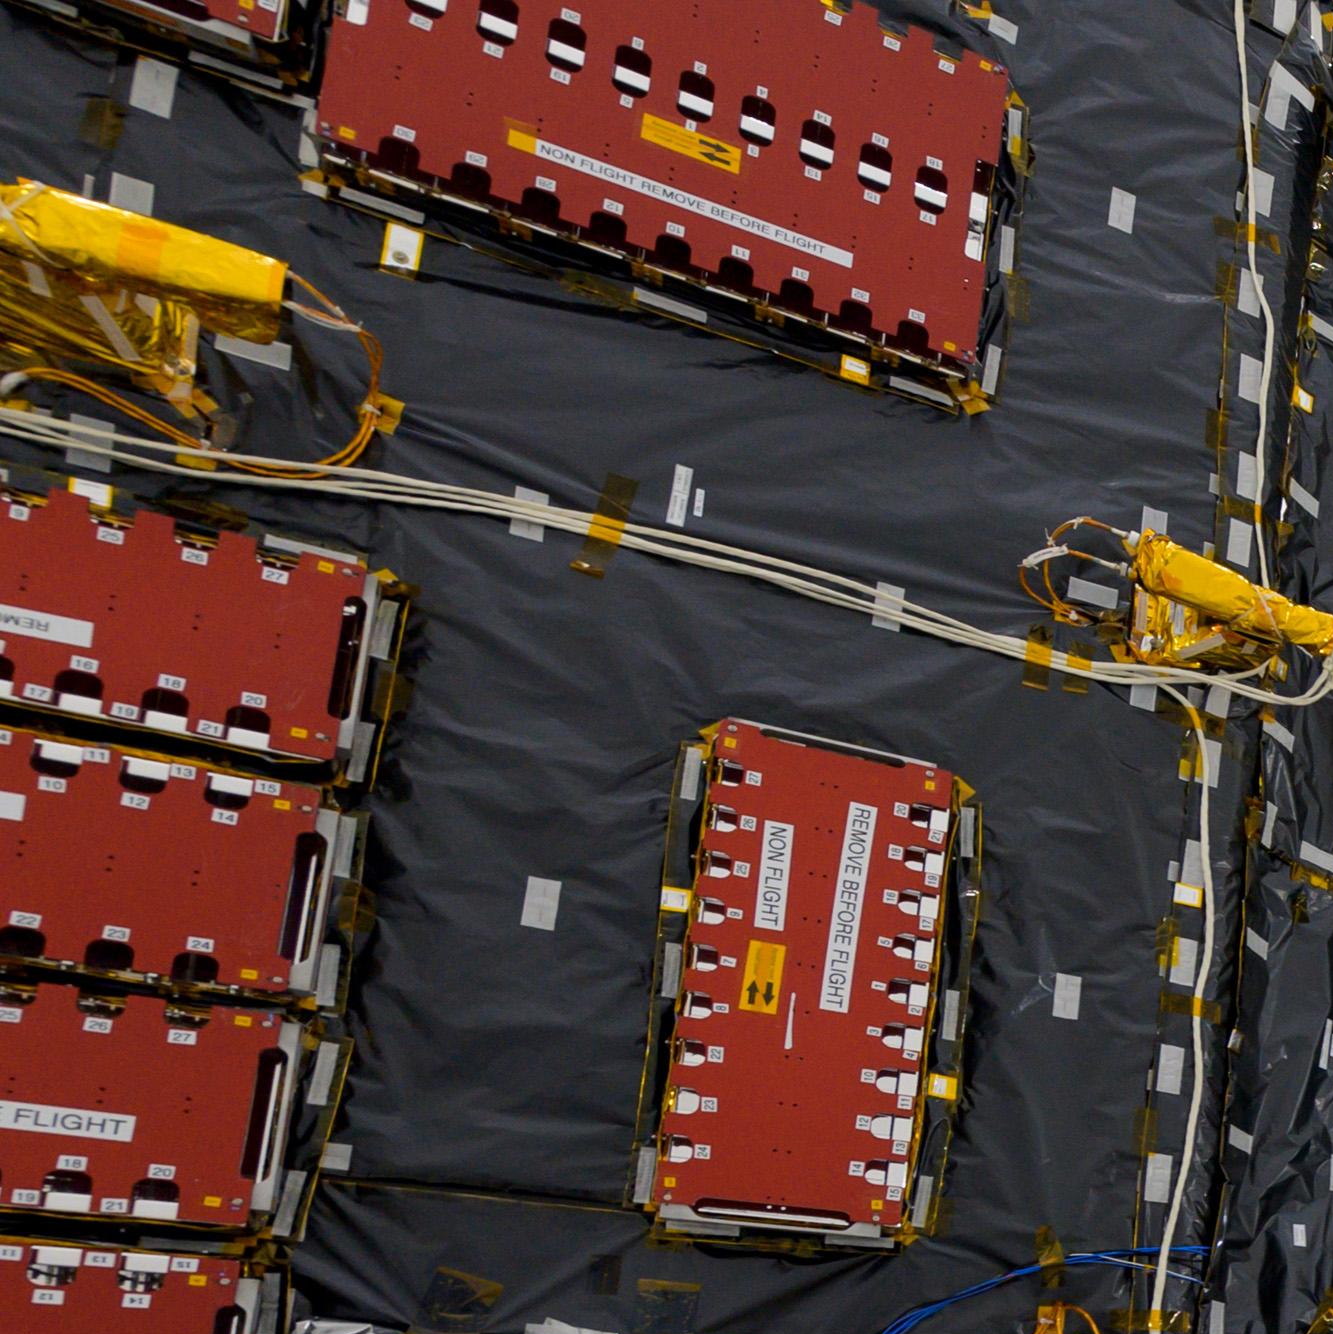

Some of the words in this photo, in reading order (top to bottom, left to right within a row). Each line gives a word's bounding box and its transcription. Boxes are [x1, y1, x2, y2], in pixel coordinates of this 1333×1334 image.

[540, 144, 576, 165] NON
[580, 159, 635, 187] FLIGHT
[641, 180, 706, 212] REMOVE
[711, 206, 770, 235] BEFORE
[775, 228, 826, 256] FLIGHT
[11, 508, 28, 518] 9
[100, 530, 122, 542] 25
[186, 551, 204, 562] 26
[265, 570, 284, 580] 27
[76, 659, 93, 671] 16
[164, 678, 181, 689] 18
[28, 687, 48, 697] 17
[245, 695, 263, 706] 20
[117, 706, 135, 717] 19
[201, 723, 218, 734] 21
[88, 751, 106, 762] 11
[175, 767, 193, 778] 13
[748, 772, 759, 784] 27
[43, 779, 64, 790] 10
[260, 783, 277, 793] 15
[129, 796, 146, 807] 12
[896, 805, 907, 816] 20
[218, 812, 235, 822] 14
[743, 818, 754, 829] 26
[843, 807, 871, 877] REMOVE
[931, 831, 941, 842] 21
[767, 825, 787, 868] NON
[891, 847, 901, 857] 18
[736, 864, 748, 875] 25
[928, 875, 938, 885] 19
[759, 871, 784, 926] FLIGHT
[886, 892, 896, 901] 16
[833, 880, 860, 946] BEFORE
[15, 914, 37, 926] 22
[922, 919, 932, 929] 17
[107, 928, 126, 940] 23
[191, 940, 210, 950] 24
[918, 962, 927, 970] 6
[825, 949, 849, 1009] FLIGHT
[911, 1006, 920, 1015] 2
[88, 1020, 108, 1031] 26
[172, 1032, 192, 1042] 27
[710, 1048, 721, 1060] 22
[864, 1071, 874, 1081] 10
[704, 1100, 715, 1111] 23
[900, 1097, 910, 1108] 11
[14, 1107, 127, 1136] FLIGHT
[858, 1116, 869, 1128] 12
[697, 1147, 708, 1157] 24
[895, 1142, 906, 1153] 13
[65, 1159, 82, 1169] 18
[852, 1164, 862, 1173] 14
[152, 1167, 173, 1177] 20
[18, 1192, 38, 1203] 19
[889, 1188, 900, 1199] 15
[105, 1201, 123, 1211] 21
[2, 1249, 16, 1257] 11
[92, 1255, 107, 1263] 13
[177, 1261, 191, 1269] 15
[38, 1293, 54, 1301] 12
